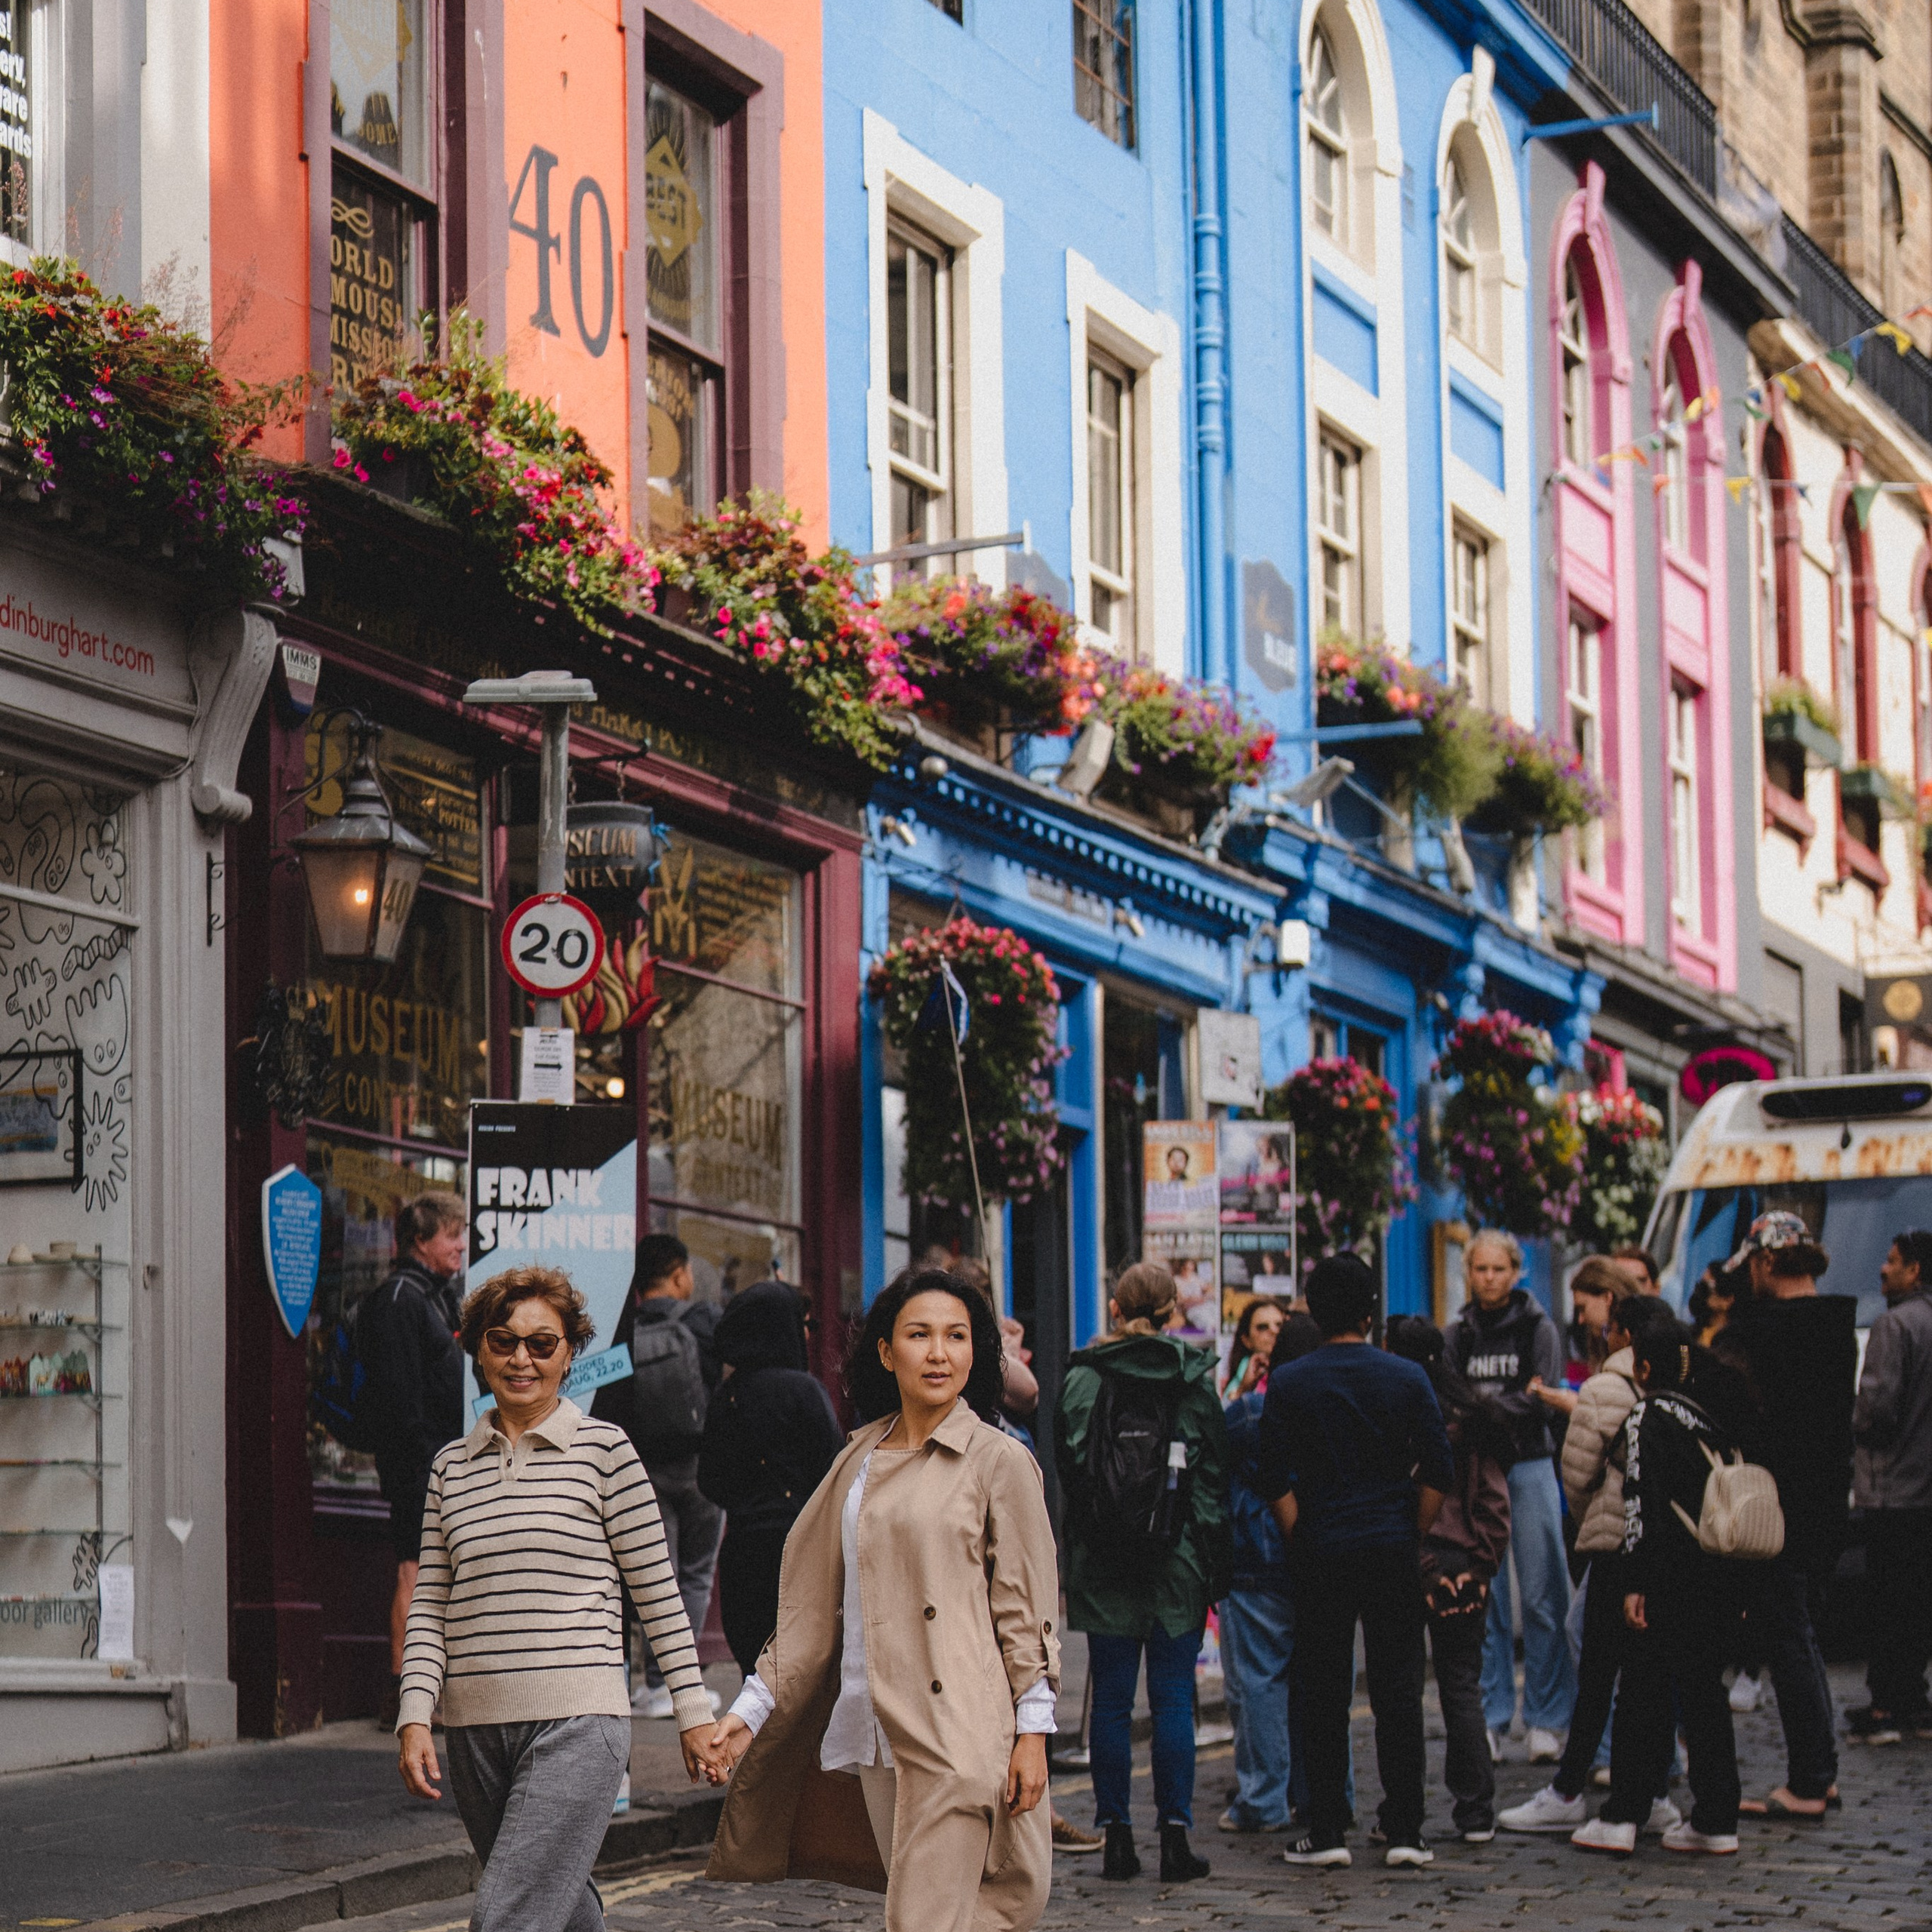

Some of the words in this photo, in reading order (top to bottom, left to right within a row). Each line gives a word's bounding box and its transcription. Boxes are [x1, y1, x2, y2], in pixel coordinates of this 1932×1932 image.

[0, 84, 28, 123] are
[509, 143, 614, 359] 40
[0, 593, 155, 676] dinburghart.com
[286, 647, 318, 671] IMMS
[383, 878, 411, 924] 40
[518, 921, 589, 970] 20
[477, 1166, 604, 1208] FRANK
[475, 1210, 636, 1251] SKINNER
[33, 1596, 88, 1631] gallery
